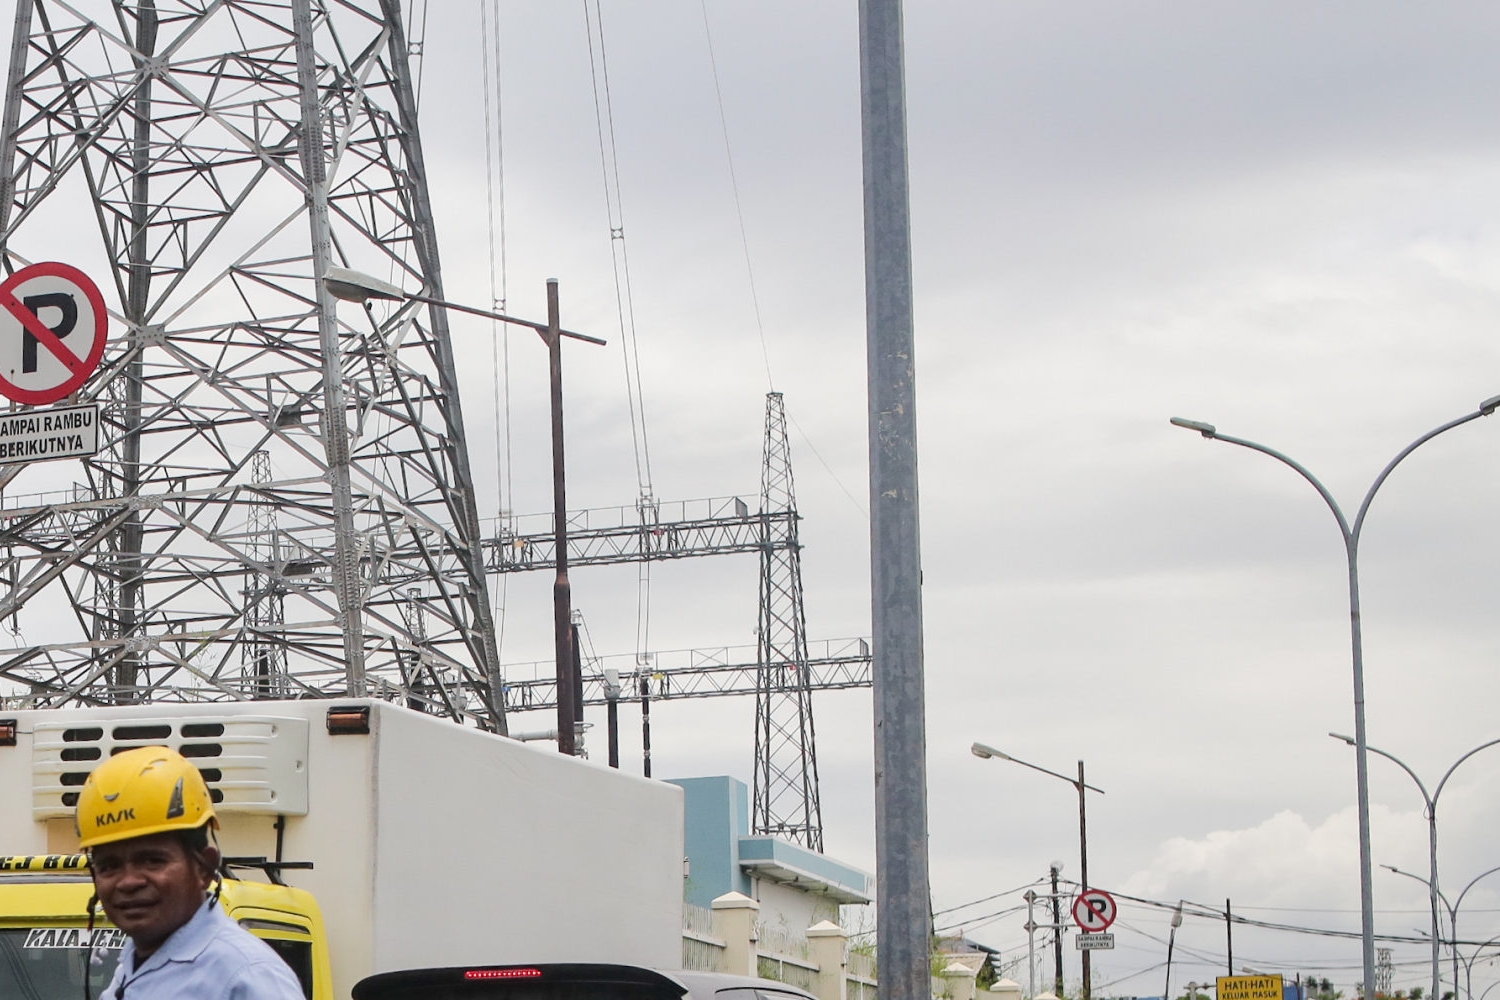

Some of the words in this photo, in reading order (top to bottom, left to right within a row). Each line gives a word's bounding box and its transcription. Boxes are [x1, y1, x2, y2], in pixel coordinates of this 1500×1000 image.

[44, 411, 92, 432] RAMBU
[0, 434, 84, 458] BERIKUTNYA
[95, 807, 136, 827] KASK
[1222, 991, 1250, 1000] KELUAR
[1252, 990, 1278, 998] MASUK
